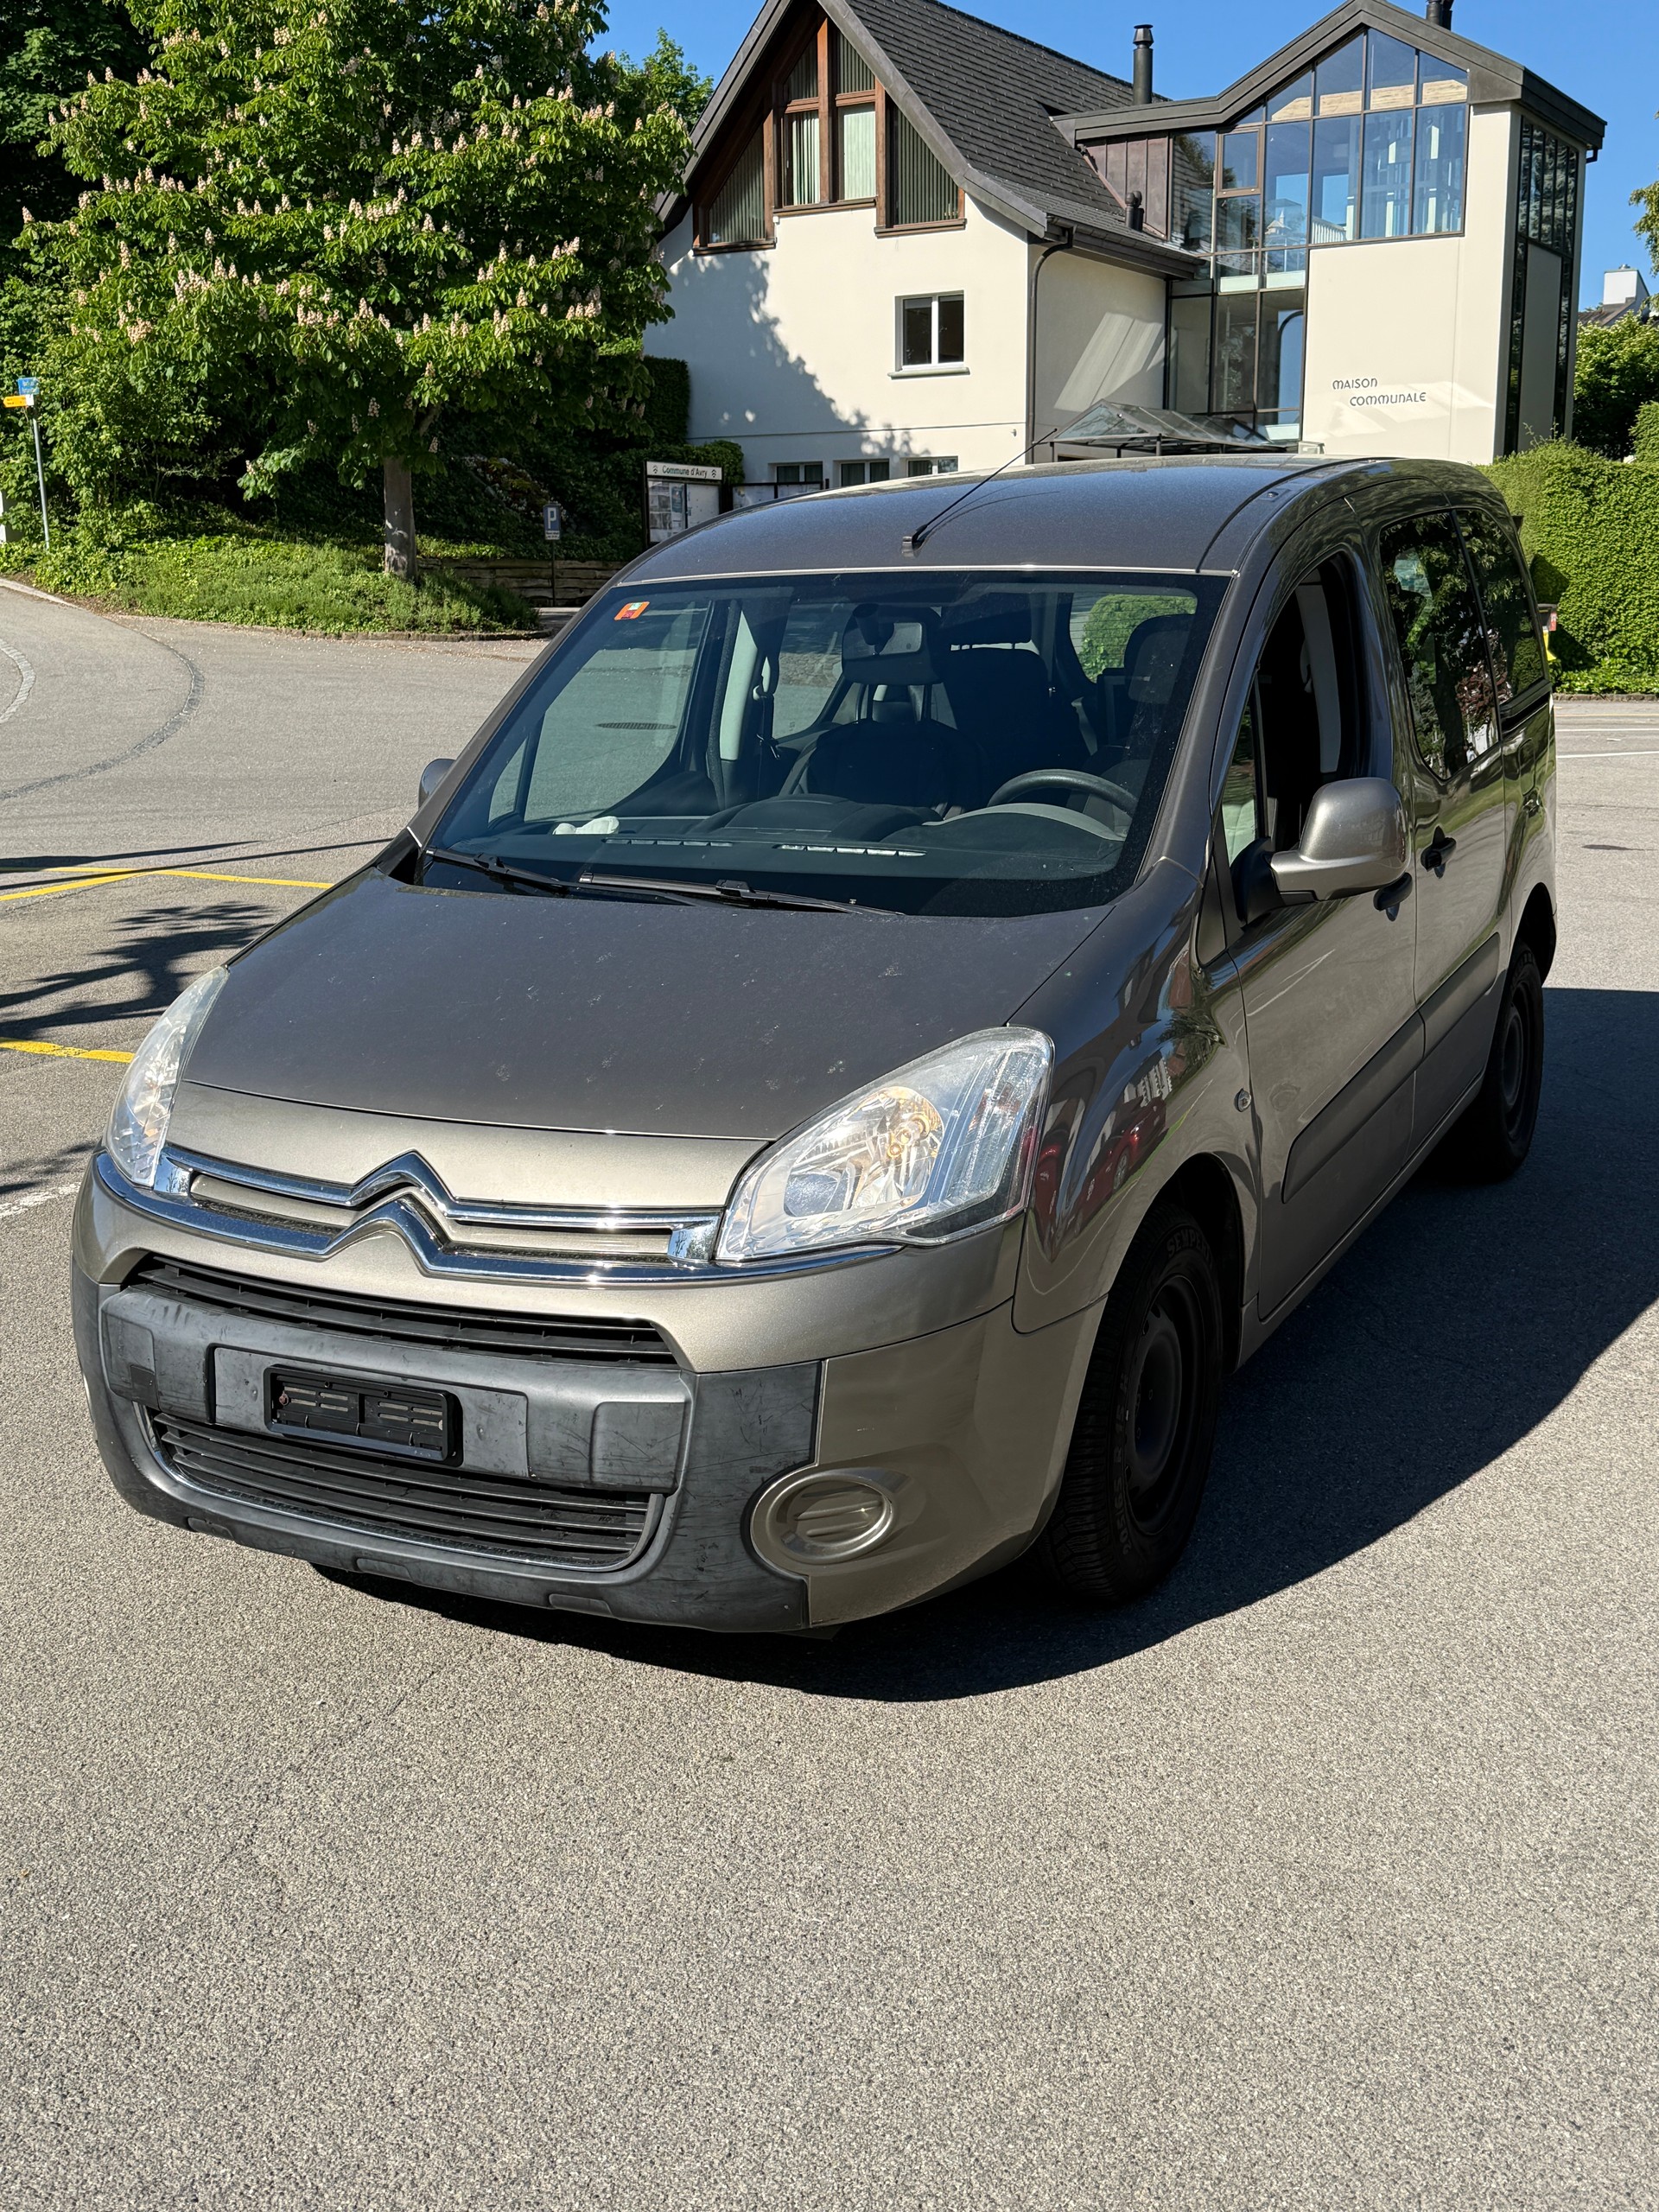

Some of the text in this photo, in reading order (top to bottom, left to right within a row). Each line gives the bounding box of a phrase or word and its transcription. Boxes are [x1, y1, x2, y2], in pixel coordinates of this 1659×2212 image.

[1332, 378, 1377, 390] MAISON
[1350, 392, 1427, 406] COMMUNALE
[662, 465, 708, 478] Commune d'Avry
[547, 507, 556, 529] P
